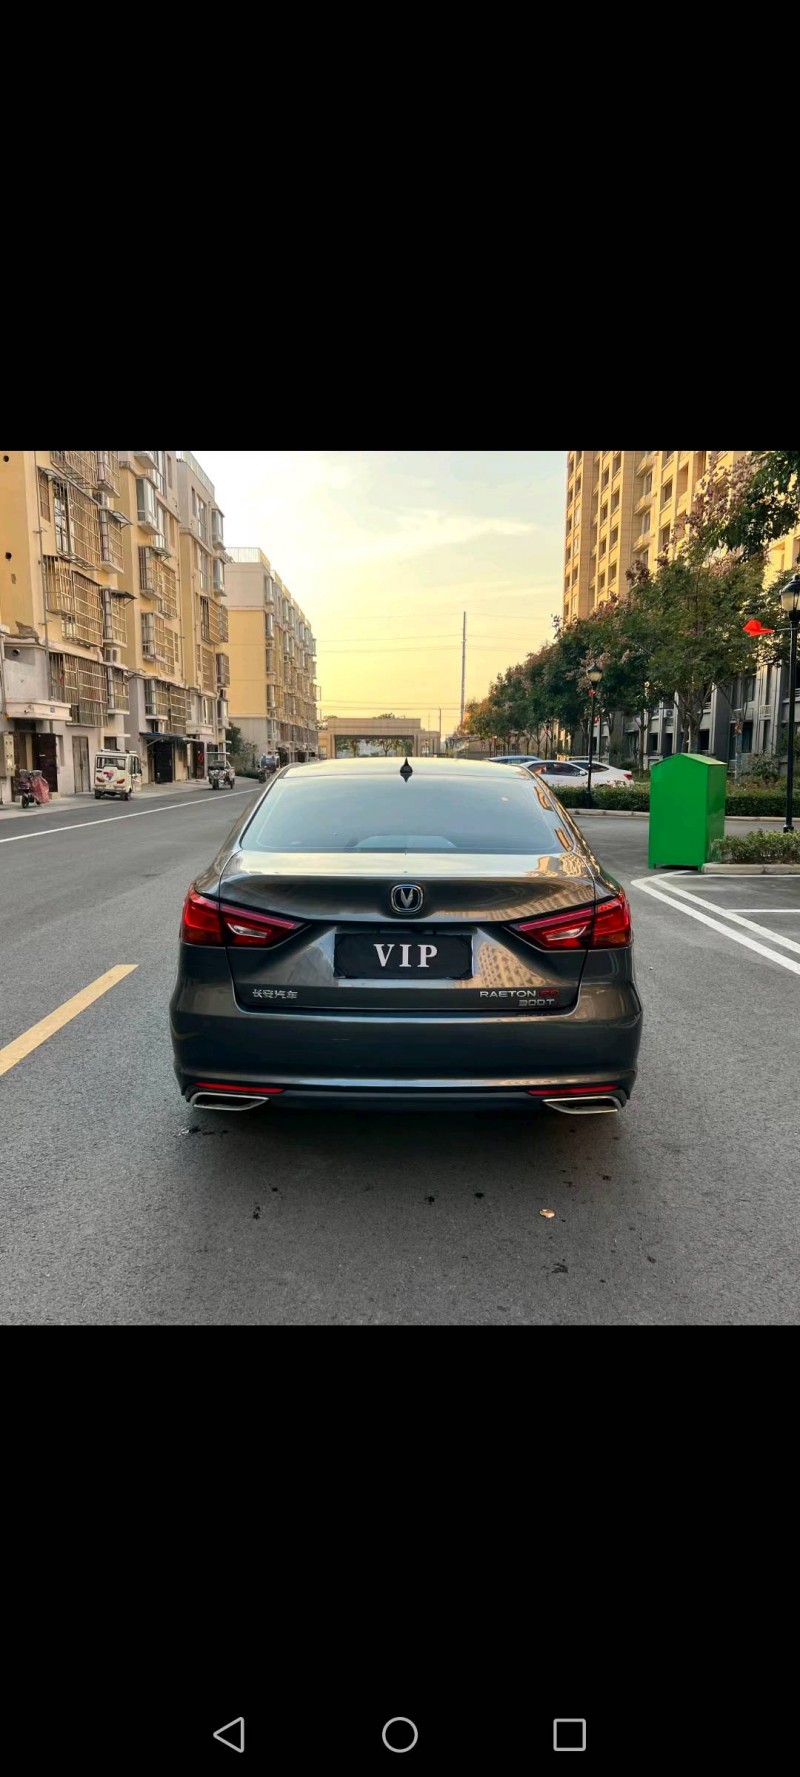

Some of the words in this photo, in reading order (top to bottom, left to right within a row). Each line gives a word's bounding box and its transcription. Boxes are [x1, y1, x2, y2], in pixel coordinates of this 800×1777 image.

[373, 943, 438, 968] VIP
[252, 988, 298, 999] 长安汽车
[479, 990, 537, 998] RAETON
